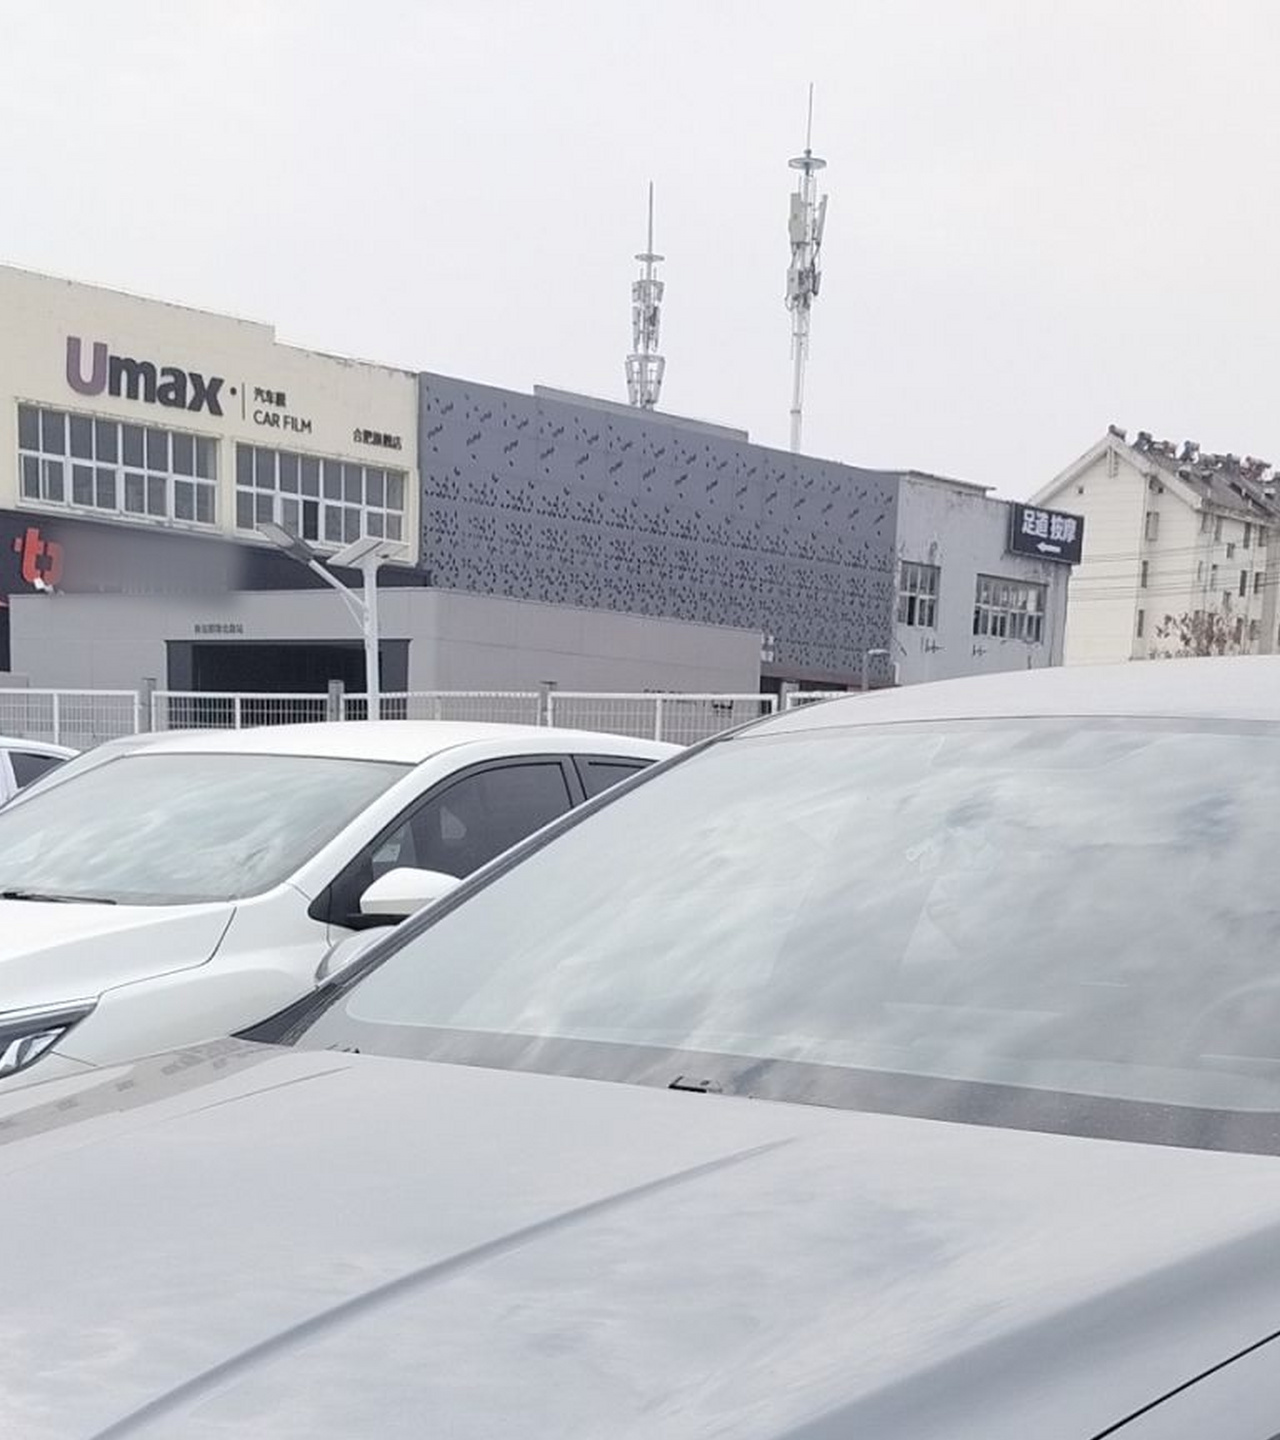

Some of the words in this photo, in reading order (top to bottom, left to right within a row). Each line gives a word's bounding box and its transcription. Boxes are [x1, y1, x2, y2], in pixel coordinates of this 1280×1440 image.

[66, 336, 225, 416] Umax
[253, 409, 281, 428] CAR
[283, 414, 313, 434] FILM
